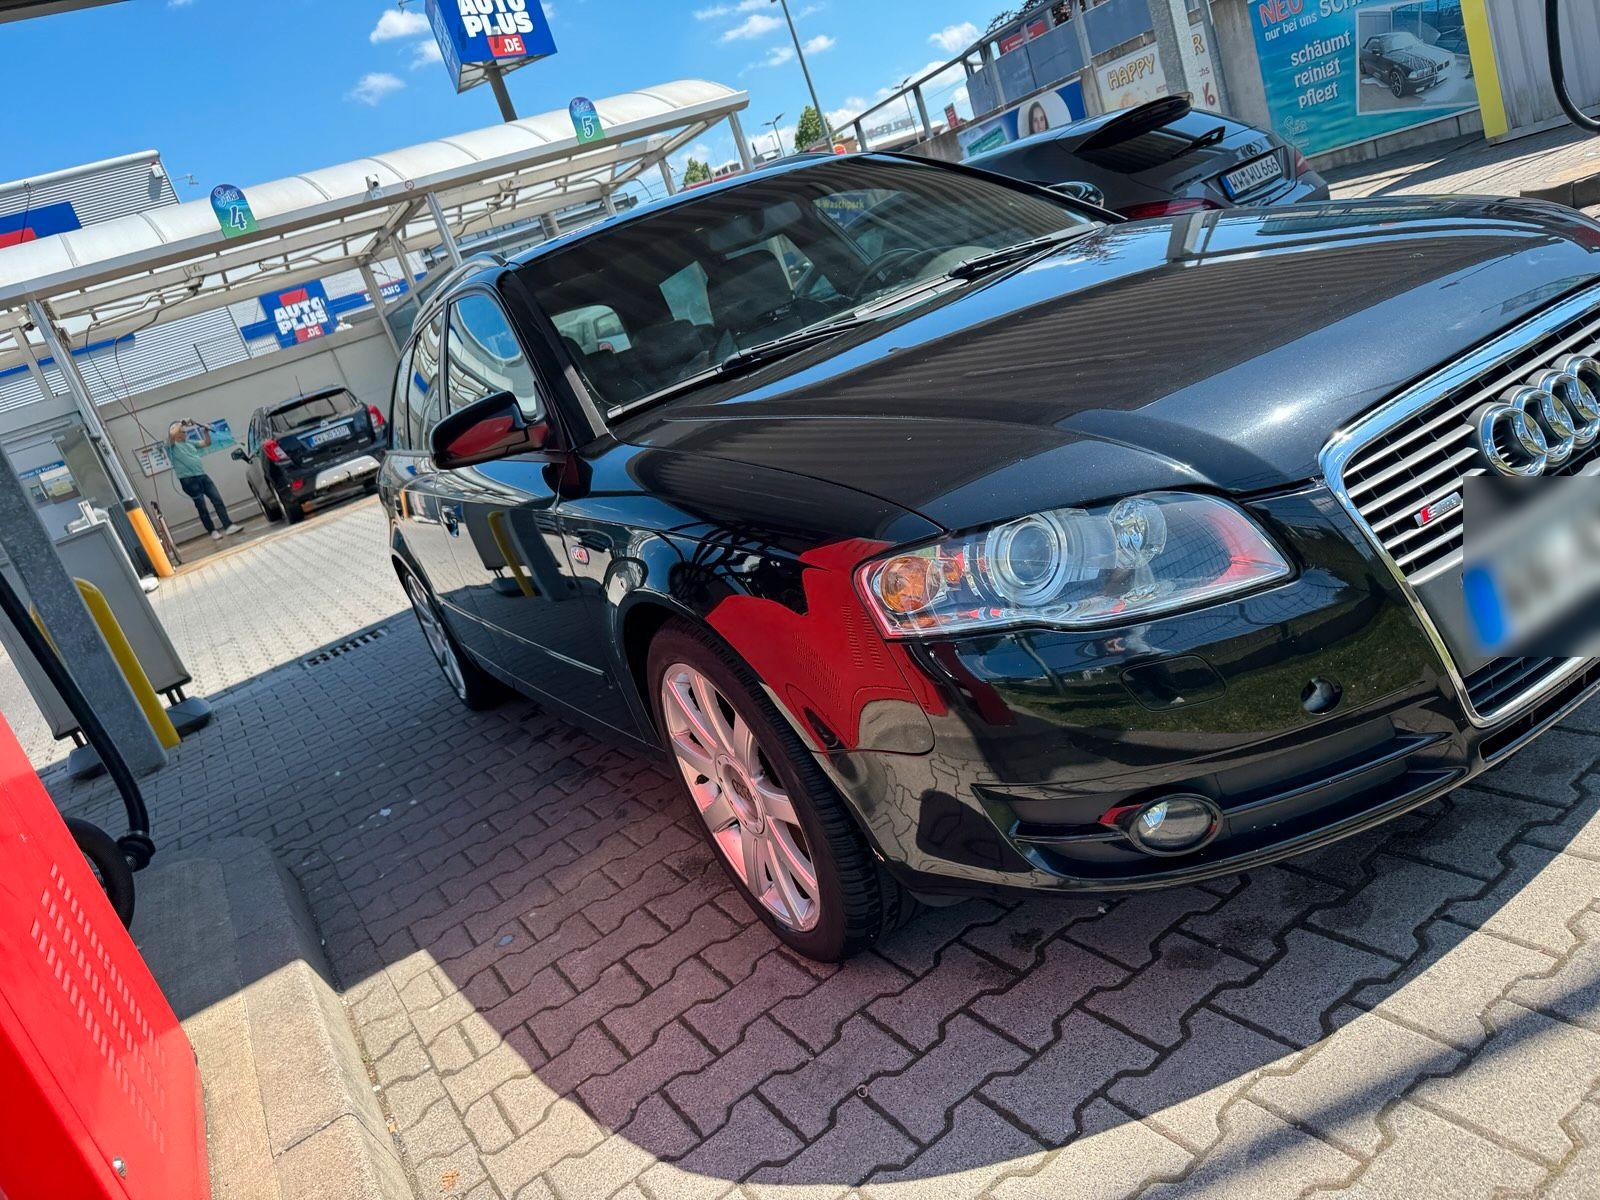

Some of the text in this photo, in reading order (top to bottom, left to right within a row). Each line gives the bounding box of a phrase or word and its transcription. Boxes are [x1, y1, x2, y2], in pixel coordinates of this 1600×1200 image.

[462, 11, 534, 38] PLUS
[1260, 0, 1304, 27] NEU
[1265, 12, 1318, 41] nur bei uns
[504, 38, 522, 53] .DE
[1290, 29, 1352, 67] schäumt
[1107, 53, 1156, 91] HAPPY
[1294, 57, 1341, 89] reinigt
[1298, 82, 1339, 109] pflegt
[582, 115, 594, 139] 5
[230, 205, 247, 230] 4
[273, 296, 326, 323] AUTO
[277, 310, 329, 336] PLUS
